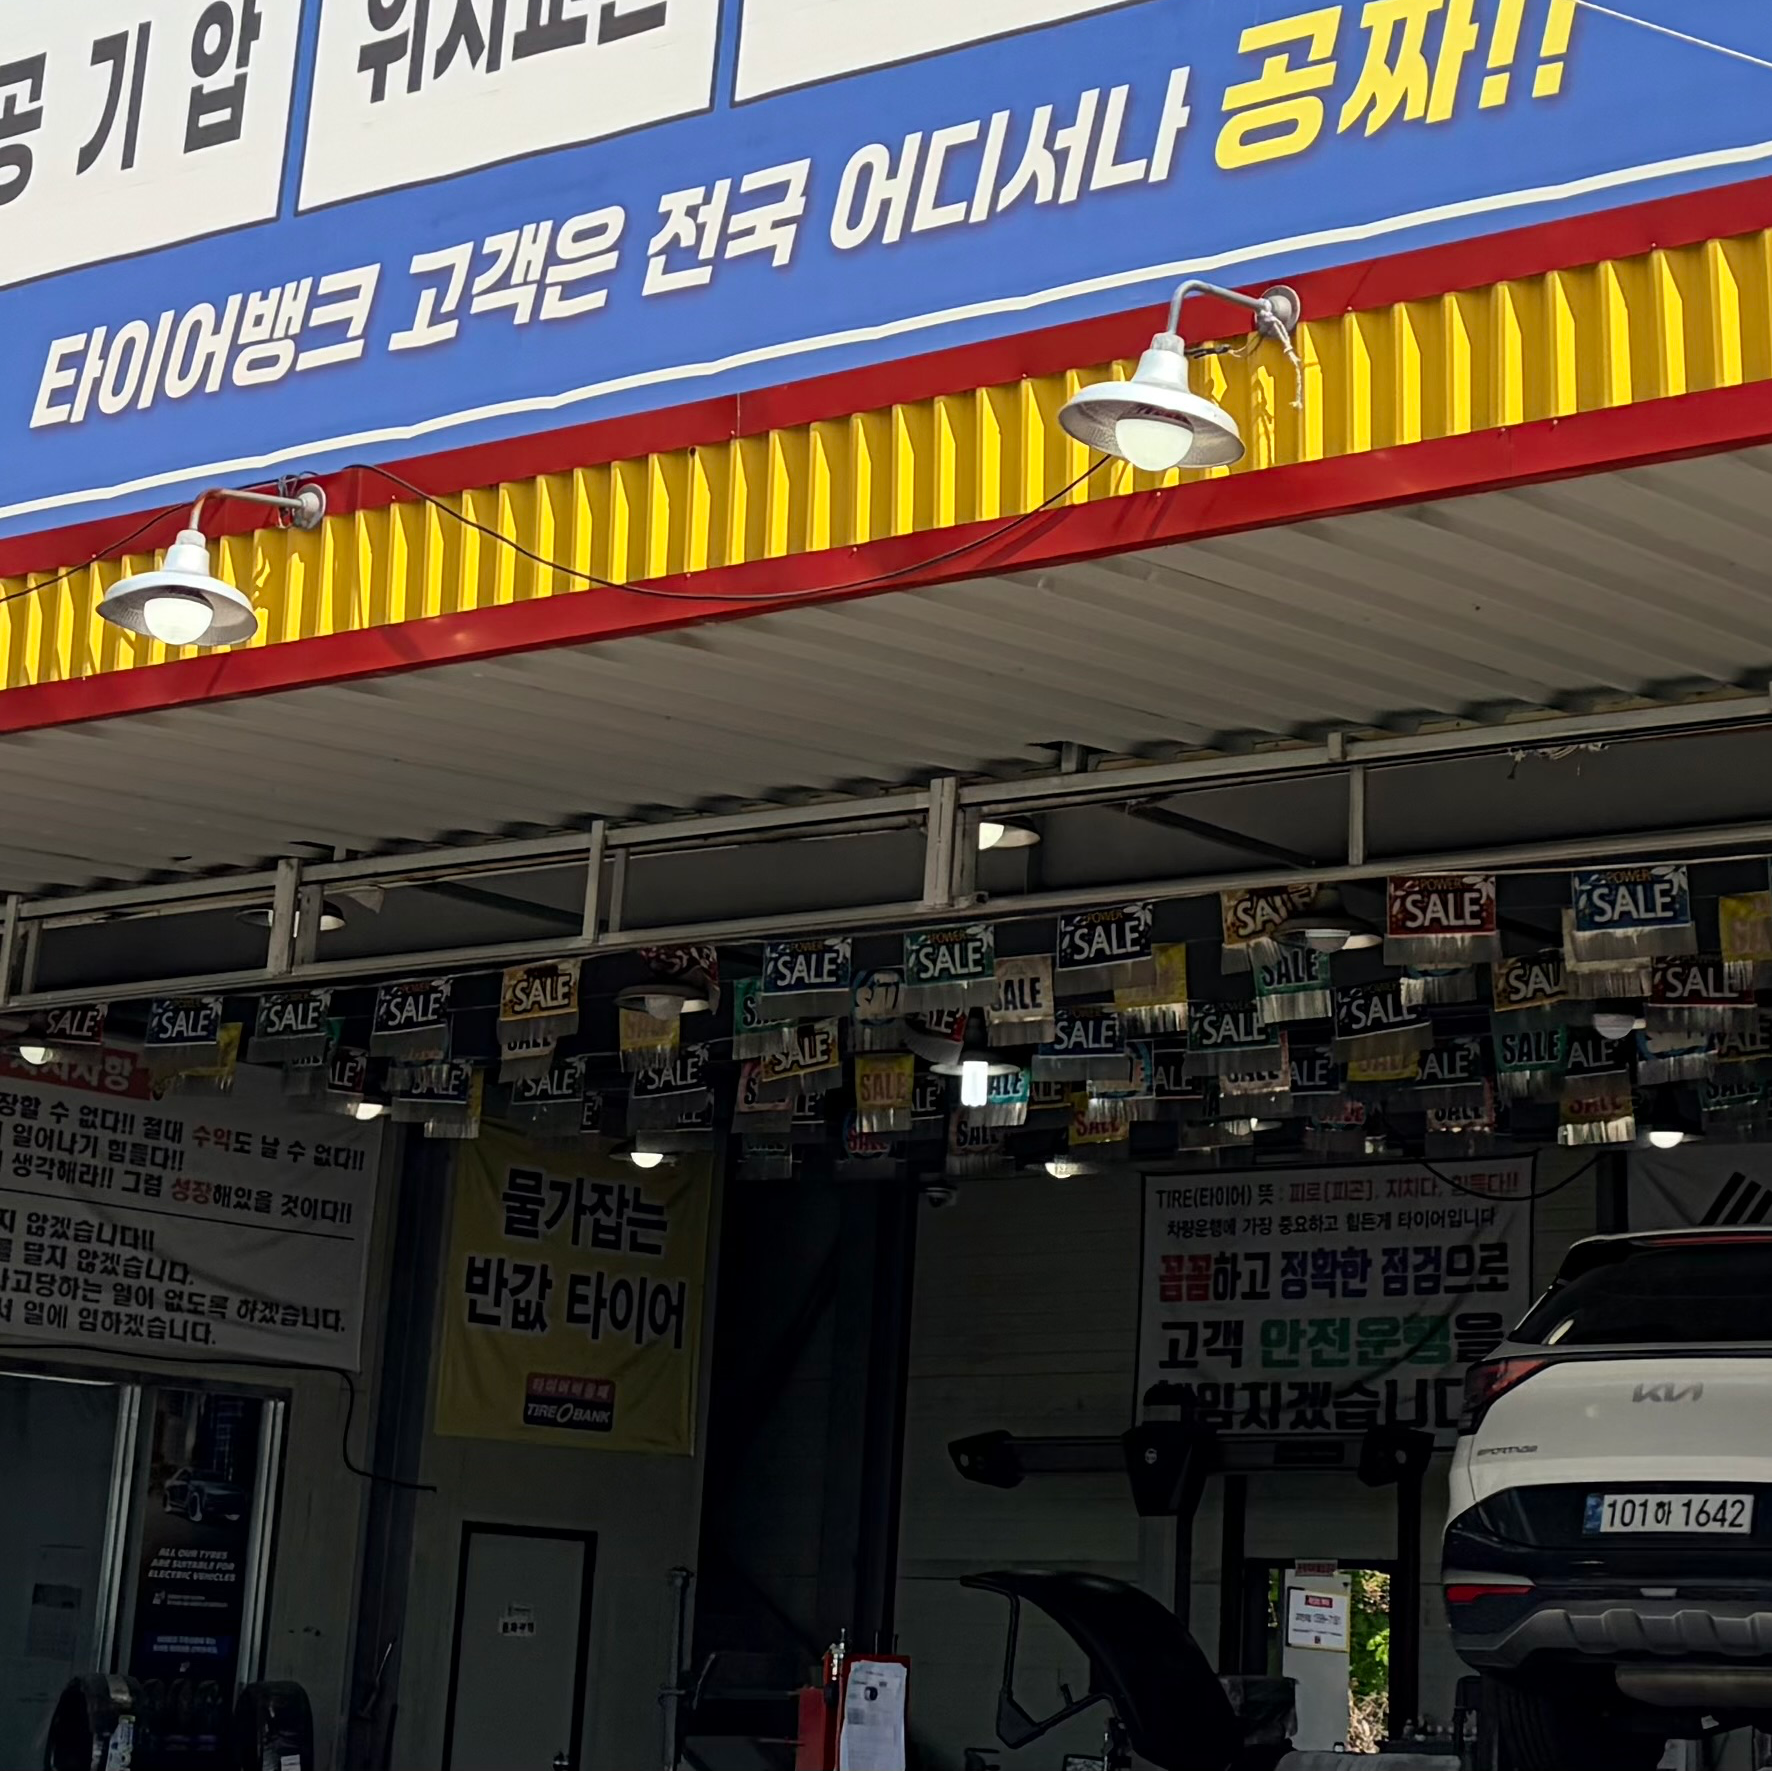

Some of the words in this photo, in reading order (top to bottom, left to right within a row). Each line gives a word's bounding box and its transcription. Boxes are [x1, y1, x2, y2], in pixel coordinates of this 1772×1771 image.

[29, 262, 384, 429] 타이어뱅크
[388, 204, 625, 354] 고객은
[641, 158, 815, 297] 전국
[829, 65, 1191, 251] 어디서나
[1404, 891, 1482, 927] SALE
[1592, 882, 1674, 923] SALE
[1073, 920, 1140, 960] SALE
[777, 951, 837, 986] SALE
[918, 942, 983, 978] SALE
[1262, 949, 1319, 987] SALE
[512, 973, 573, 1014] SALE
[1509, 961, 1564, 1000] SAL
[46, 1009, 97, 1038] SALE
[160, 1010, 208, 1039] SALE
[267, 1002, 321, 1033] SALE
[388, 992, 441, 1026] SALE
[1055, 1015, 1115, 1049] SALE
[1501, 1029, 1561, 1064] SALE
[1417, 1053, 1470, 1081] ALE
[1568, 1037, 1614, 1069] ALE
[524, 1067, 575, 1096] SALE
[648, 1057, 698, 1089] SALE
[990, 1071, 1024, 1095] ALE
[1154, 1064, 1193, 1091] ALE
[1291, 1059, 1329, 1086] ALE
[12, 1123, 98, 1158] 일어나기
[50, 1101, 69, 1125] 수
[79, 1104, 135, 1136] 없다!!
[143, 1116, 184, 1144] 절대
[191, 1124, 253, 1154] 수익도
[287, 1140, 306, 1162] 수
[313, 1144, 365, 1172] 없다!!
[12, 1152, 113, 1190] 생각해라!!
[122, 1170, 162, 1197] 그럼
[172, 1178, 273, 1214] 성장해있을
[281, 1193, 353, 1224] 것이다!!
[502, 1168, 668, 1255] 물가잡는
[1277, 1210, 1340, 1236] 중요하고
[1397, 1205, 1496, 1231] 타이어입니다
[26, 1211, 155, 1252] 않겠습니다!!
[78, 1248, 195, 1285] 않겠습니다.
[1158, 1251, 1271, 1303] 꼼꼼하고
[1280, 1246, 1372, 1300] 정확한
[1381, 1241, 1510, 1298] 점검으로
[112, 1282, 154, 1310] 일이
[164, 1289, 230, 1319] 없도록
[237, 1299, 346, 1333] 하겠습니다.
[465, 1256, 553, 1332] 반값
[567, 1271, 685, 1349] 타이어
[24, 1300, 68, 1329] 일에
[78, 1308, 217, 1345] 임하겠습니다.
[1159, 1319, 1244, 1369] 고객
[1260, 1311, 1506, 1369] 안전운행을
[1682, 1498, 1746, 1529] 1642
